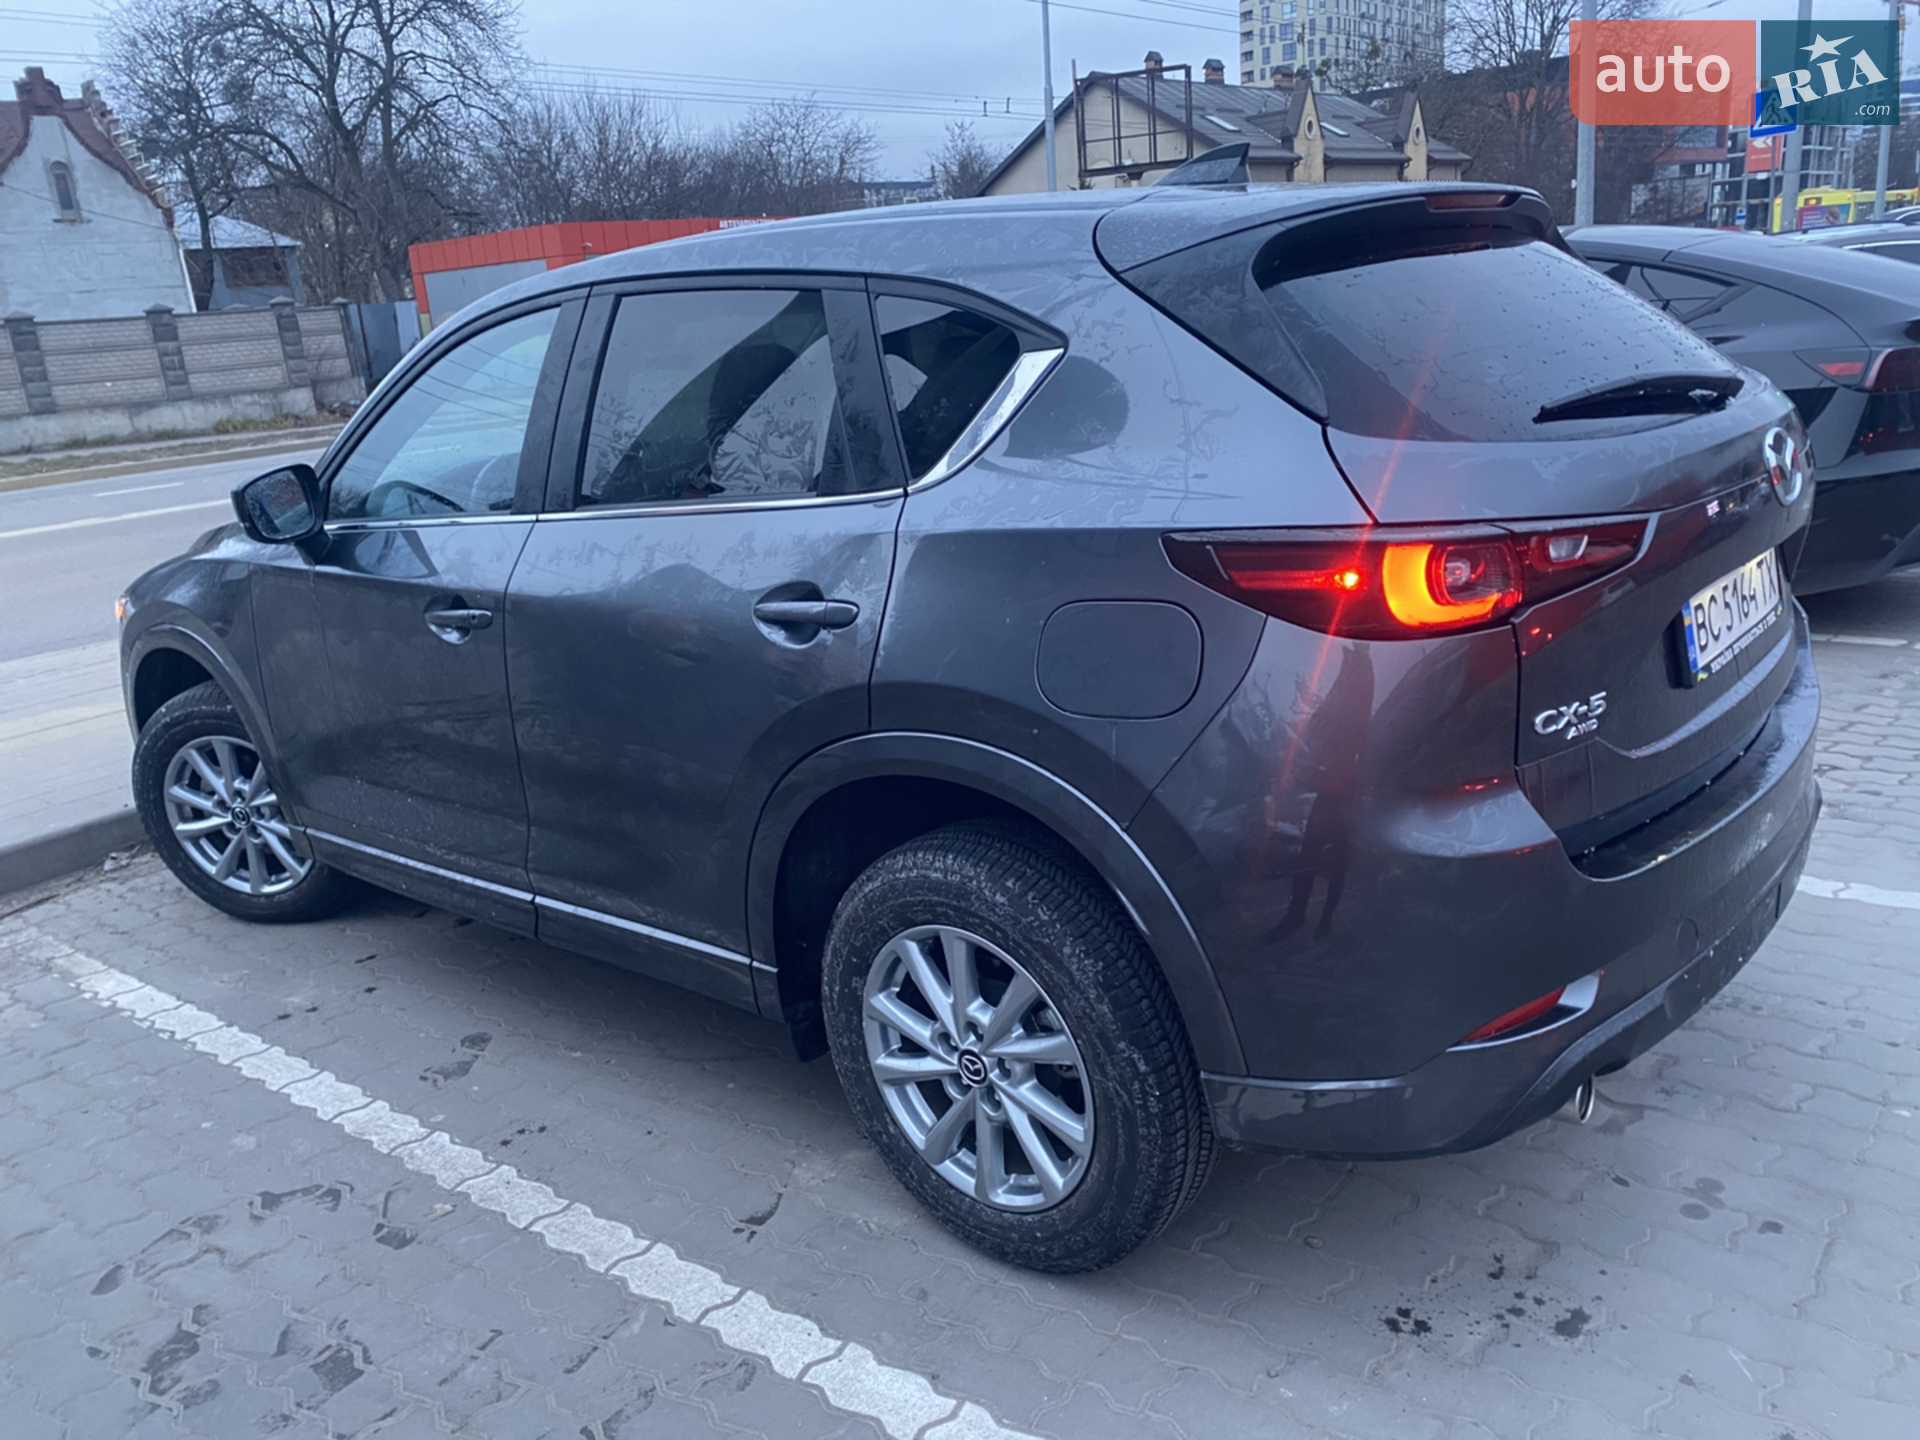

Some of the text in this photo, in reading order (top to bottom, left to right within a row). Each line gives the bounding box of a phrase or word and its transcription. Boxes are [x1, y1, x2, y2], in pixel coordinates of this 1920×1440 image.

[1694, 594, 1722, 652] BC
[1722, 567, 1759, 631] 5164
[1756, 551, 1777, 604] TX
[1534, 691, 1607, 735] CX-5
[1565, 718, 1599, 740] AWD
